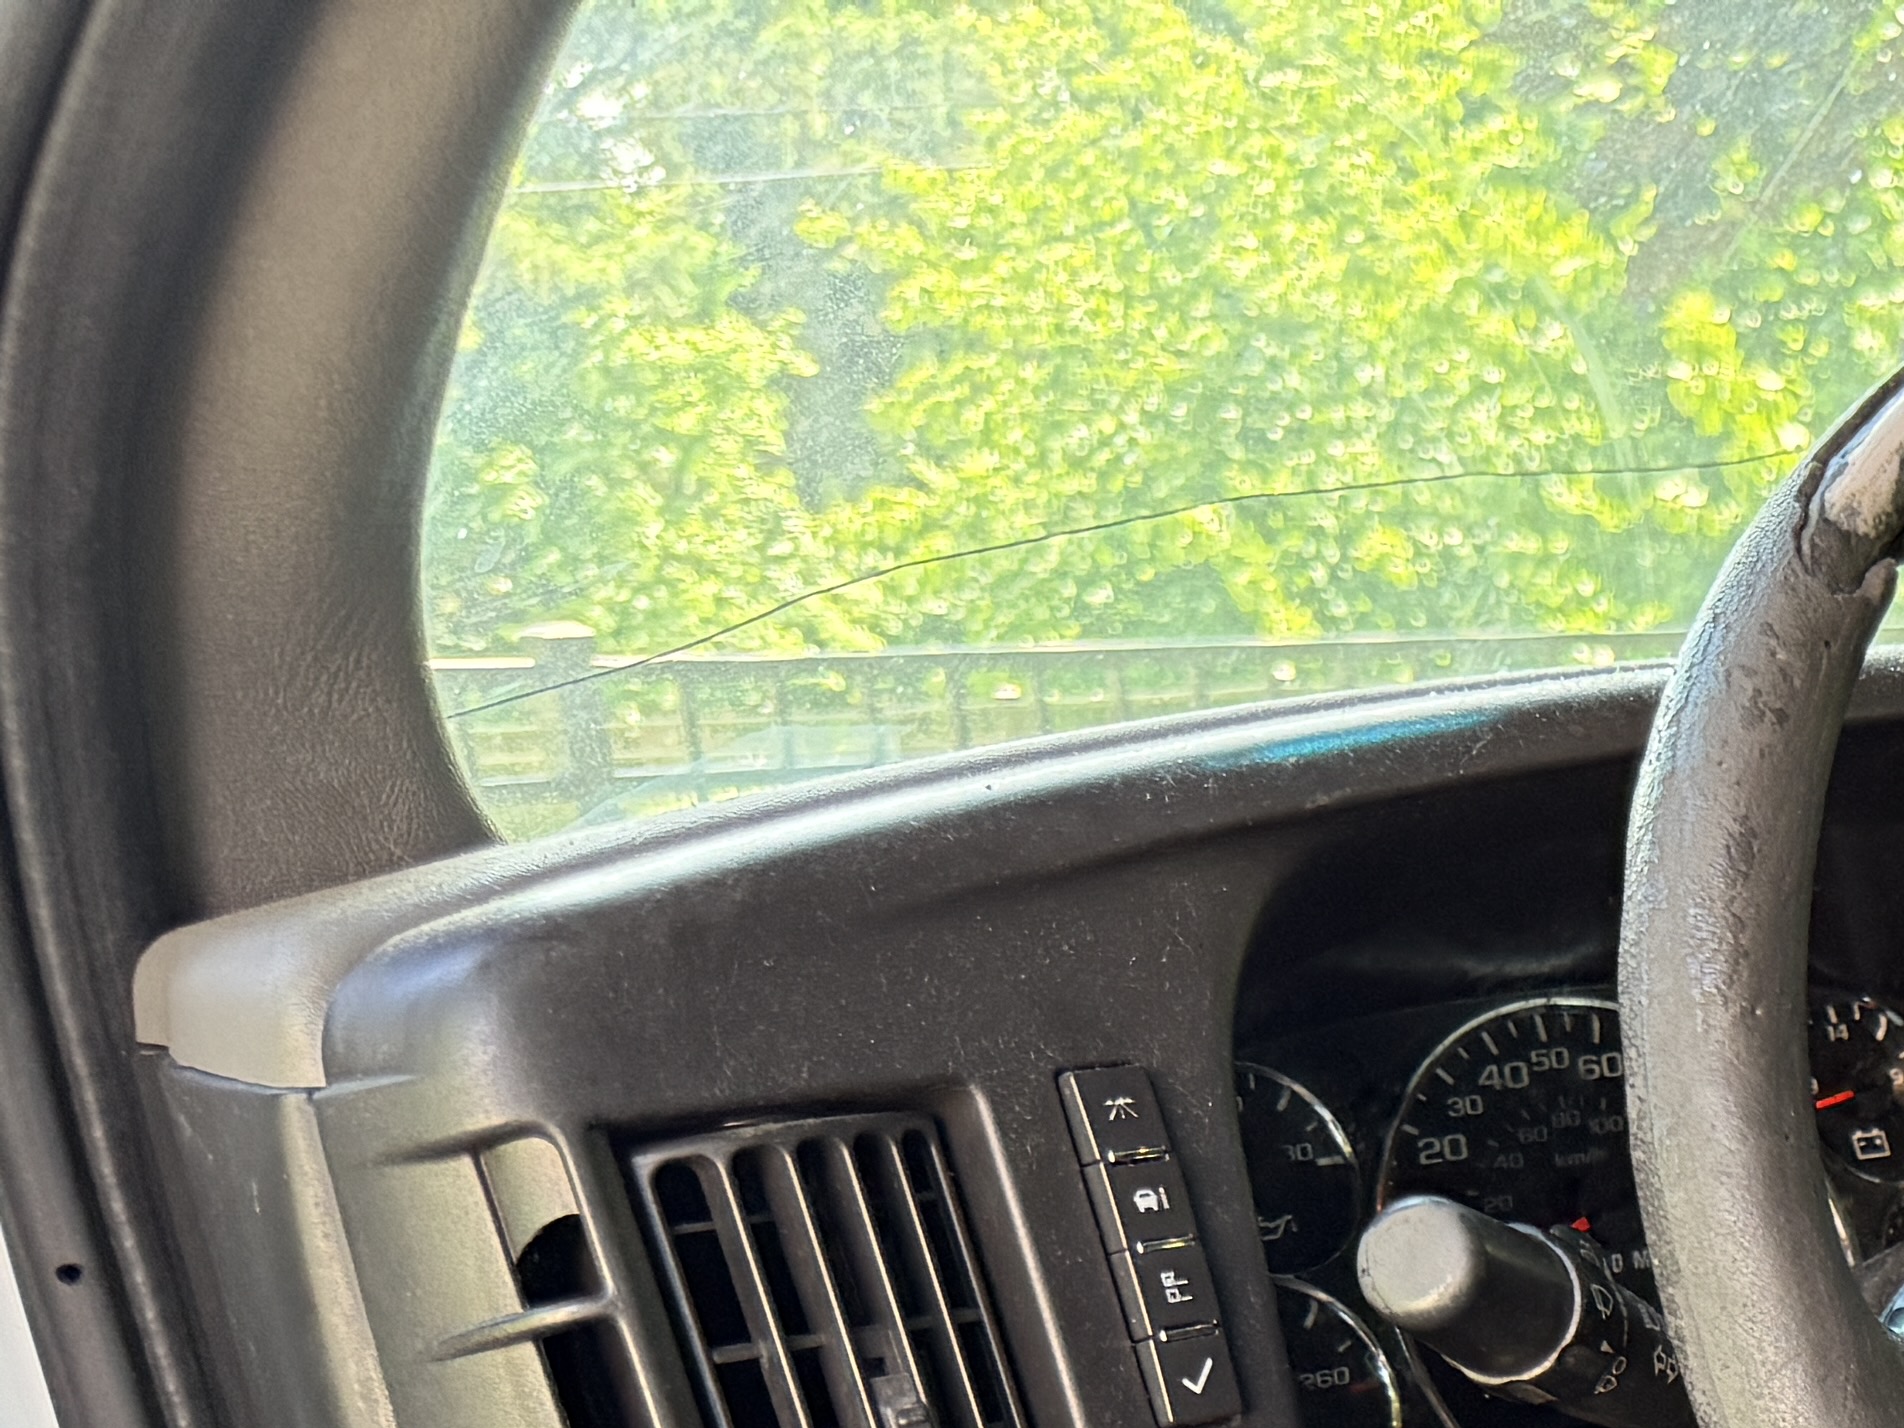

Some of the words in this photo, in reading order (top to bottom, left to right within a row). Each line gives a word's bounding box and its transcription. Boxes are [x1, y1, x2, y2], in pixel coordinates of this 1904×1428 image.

[1531, 1047, 1570, 1071] 50
[1578, 1052, 1624, 1080] 60
[1478, 1061, 1530, 1090] 40
[1447, 1095, 1484, 1117] 30
[1417, 1134, 1468, 1165] 20
[1299, 1366, 1351, 1391] 260
